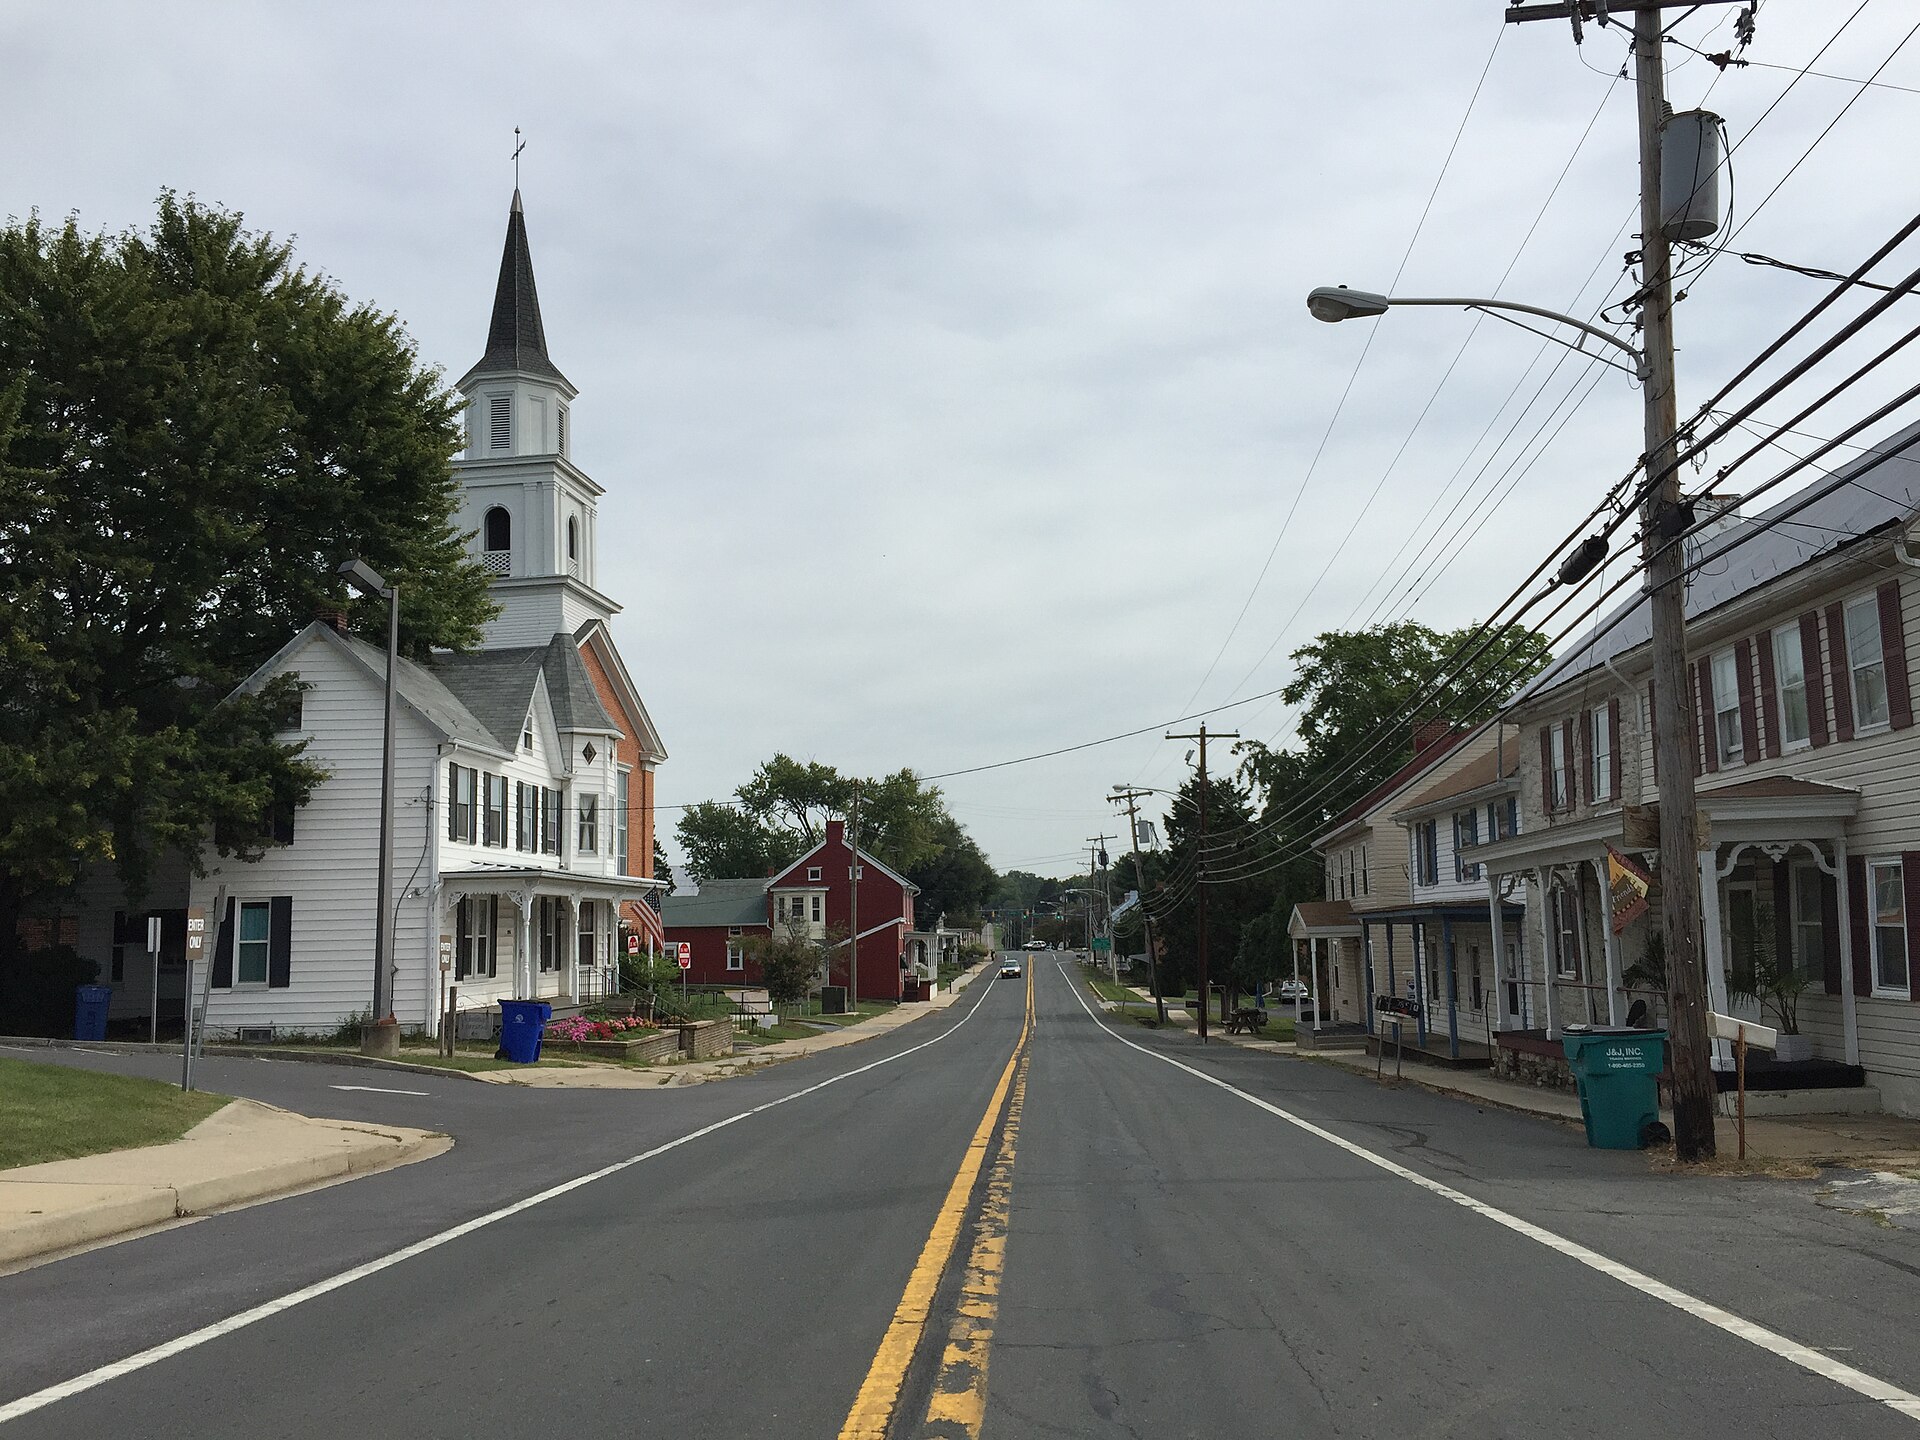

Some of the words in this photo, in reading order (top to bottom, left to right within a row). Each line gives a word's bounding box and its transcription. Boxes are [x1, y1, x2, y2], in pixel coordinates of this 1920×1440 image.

[188, 918, 204, 931] ENTER
[190, 936, 202, 949] ONLY
[440, 942, 451, 951] ENTER
[1606, 1048, 1625, 1057] J&J,
[1625, 1047, 1644, 1056] INC.
